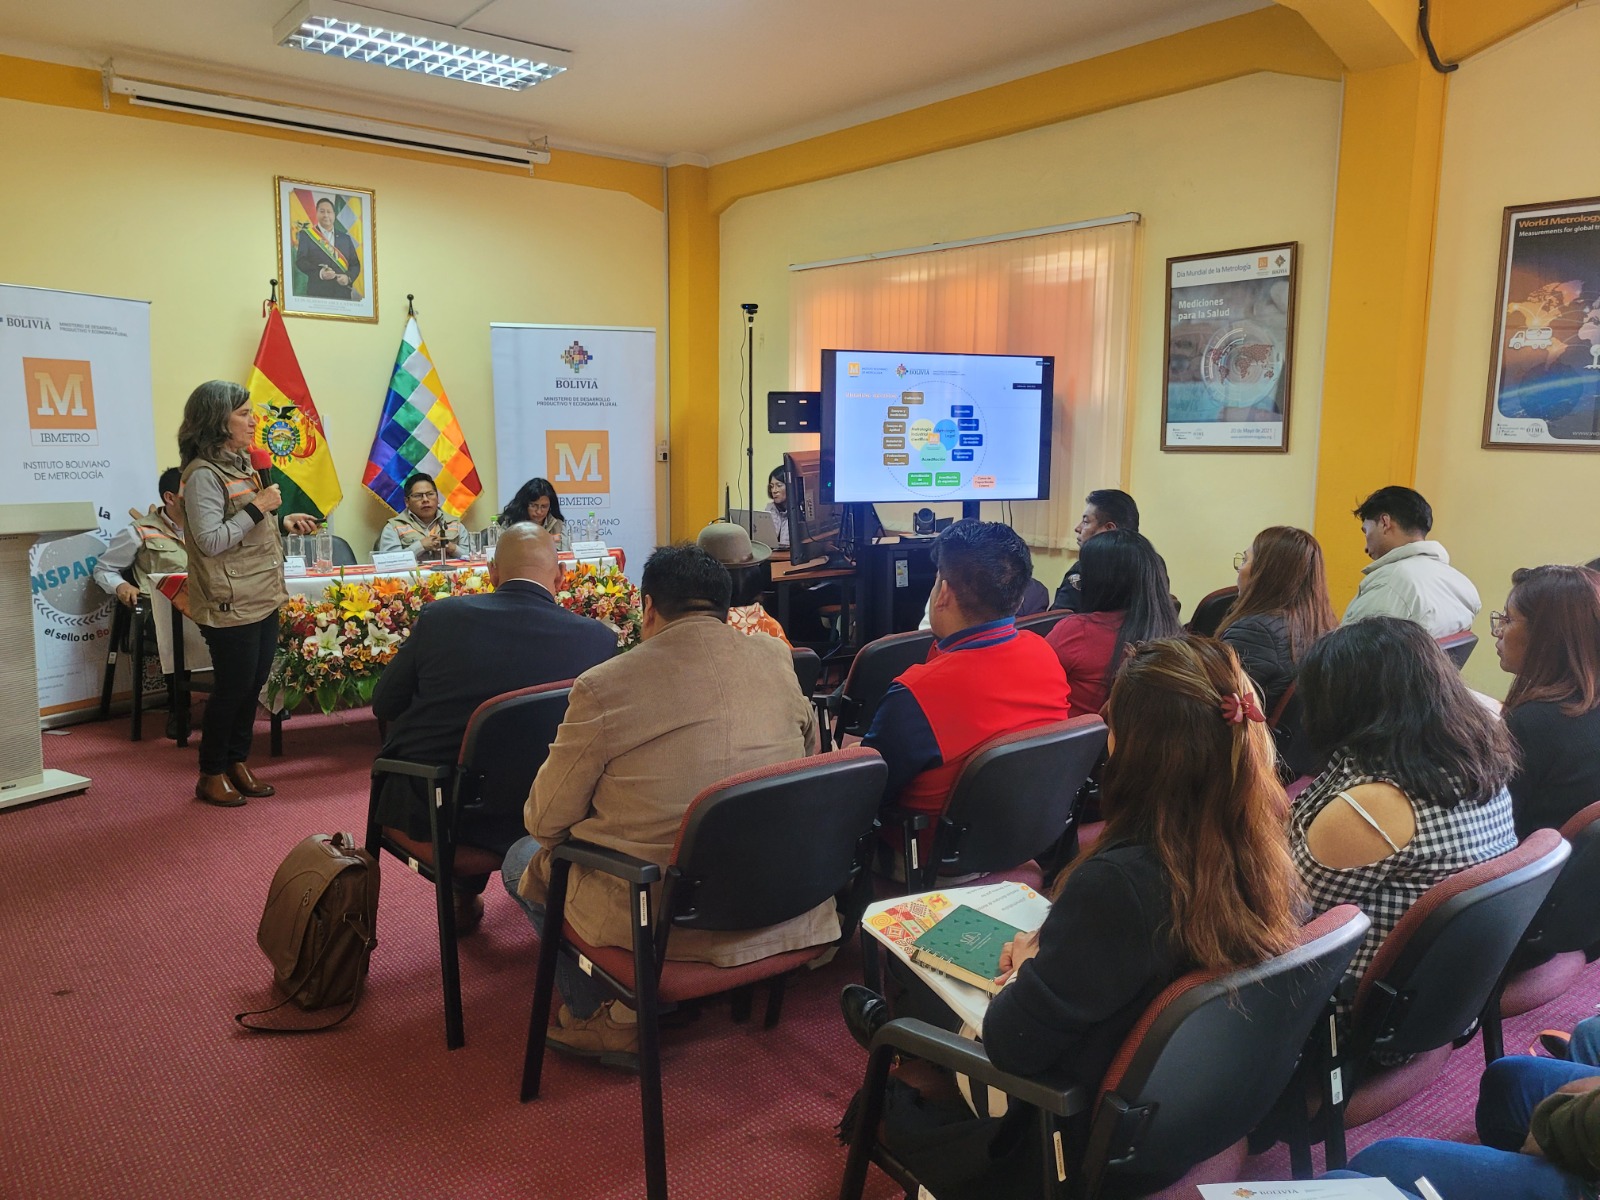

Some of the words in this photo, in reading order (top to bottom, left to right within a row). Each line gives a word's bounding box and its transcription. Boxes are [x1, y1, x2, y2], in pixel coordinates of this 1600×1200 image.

[1519, 218, 1549, 228] World
[1519, 229, 1562, 237] Measurements
[1574, 224, 1594, 233] global
[1186, 268, 1207, 277] Mundial
[1178, 298, 1224, 309] Mediciones
[1178, 311, 1196, 322] para
[1198, 310, 1206, 319] la
[1207, 308, 1230, 318] Salud
[6, 316, 52, 330] BOLIVIA
[555, 380, 599, 389] BOLIVIA
[34, 372, 88, 416] M
[40, 433, 90, 443] IBMETRO
[23, 461, 63, 469] INSTITUTO
[65, 460, 110, 469] BOLIVIANO
[555, 443, 602, 482] M
[34, 472, 46, 480] DE
[48, 470, 104, 480] METROLOGÍA
[99, 506, 111, 520] la
[44, 628, 55, 637] el
[55, 632, 80, 641] sello
[82, 632, 95, 641] de
